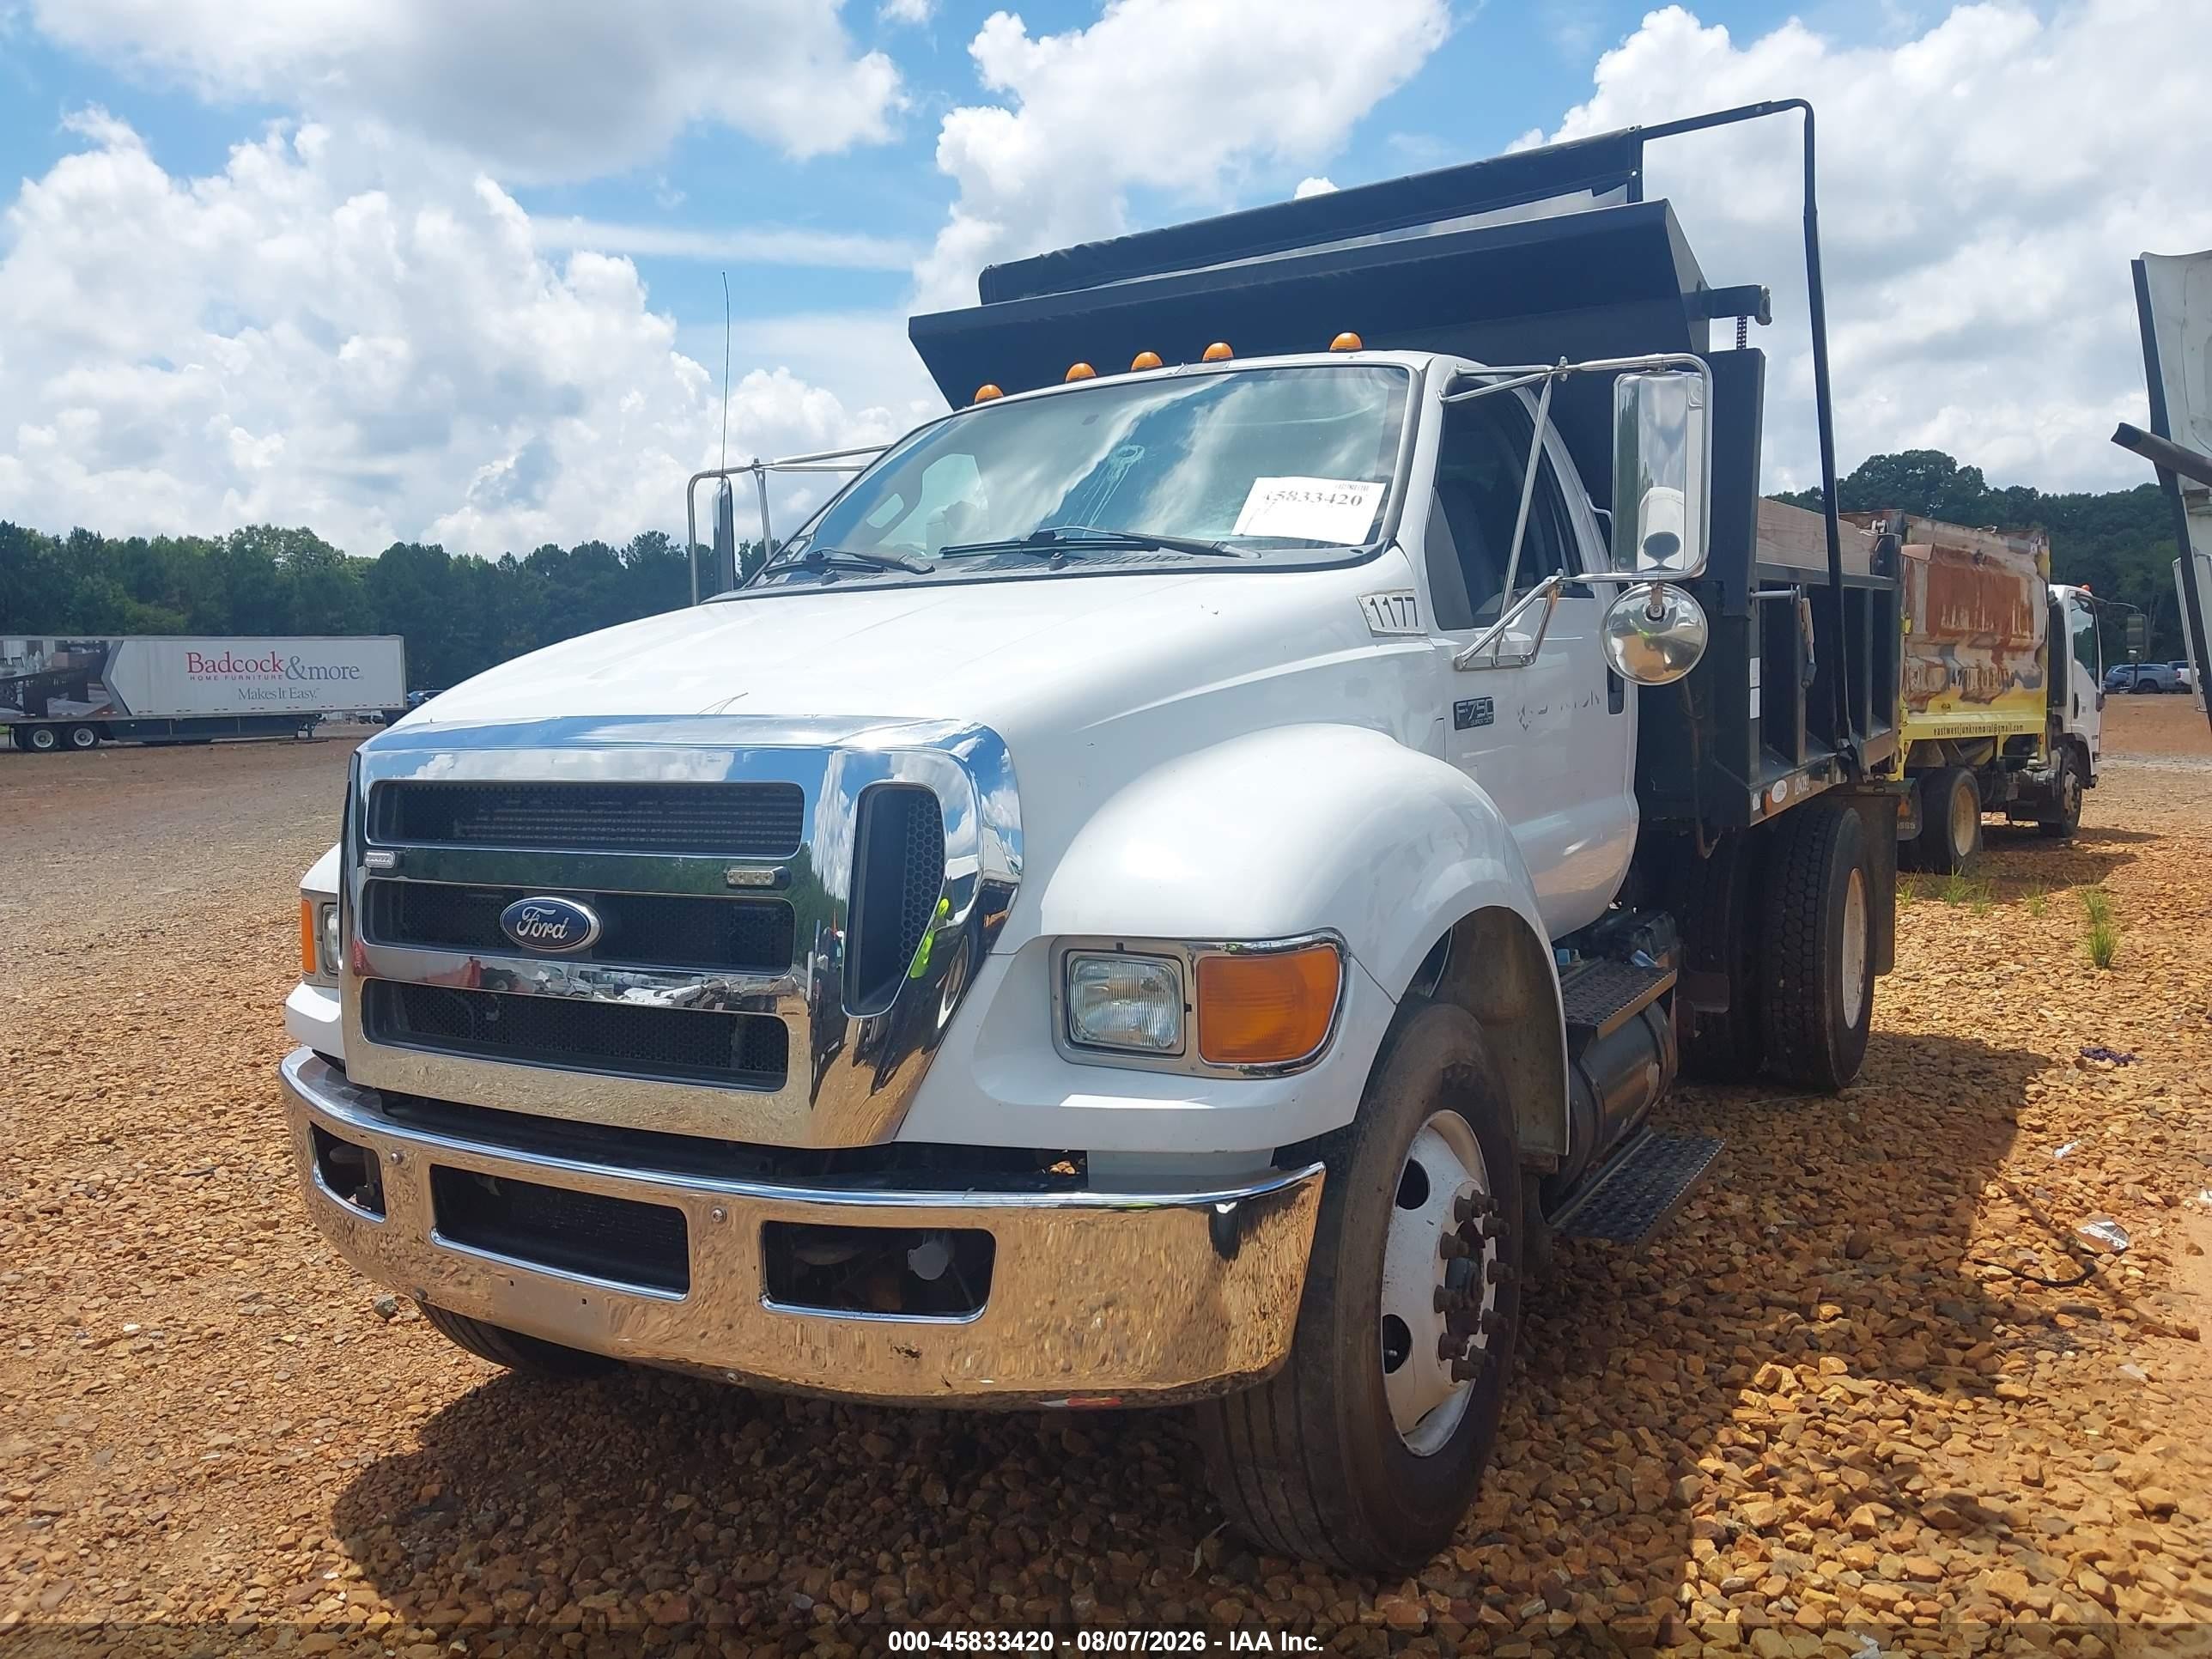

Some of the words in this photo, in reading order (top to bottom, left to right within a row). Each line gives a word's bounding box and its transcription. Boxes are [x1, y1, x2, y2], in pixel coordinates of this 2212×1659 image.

[1370, 596, 1419, 628] 1177
[185, 651, 284, 674] Badcock
[238, 688, 276, 701] Makes
[278, 687, 287, 700] It
[516, 906, 570, 939] Ford
